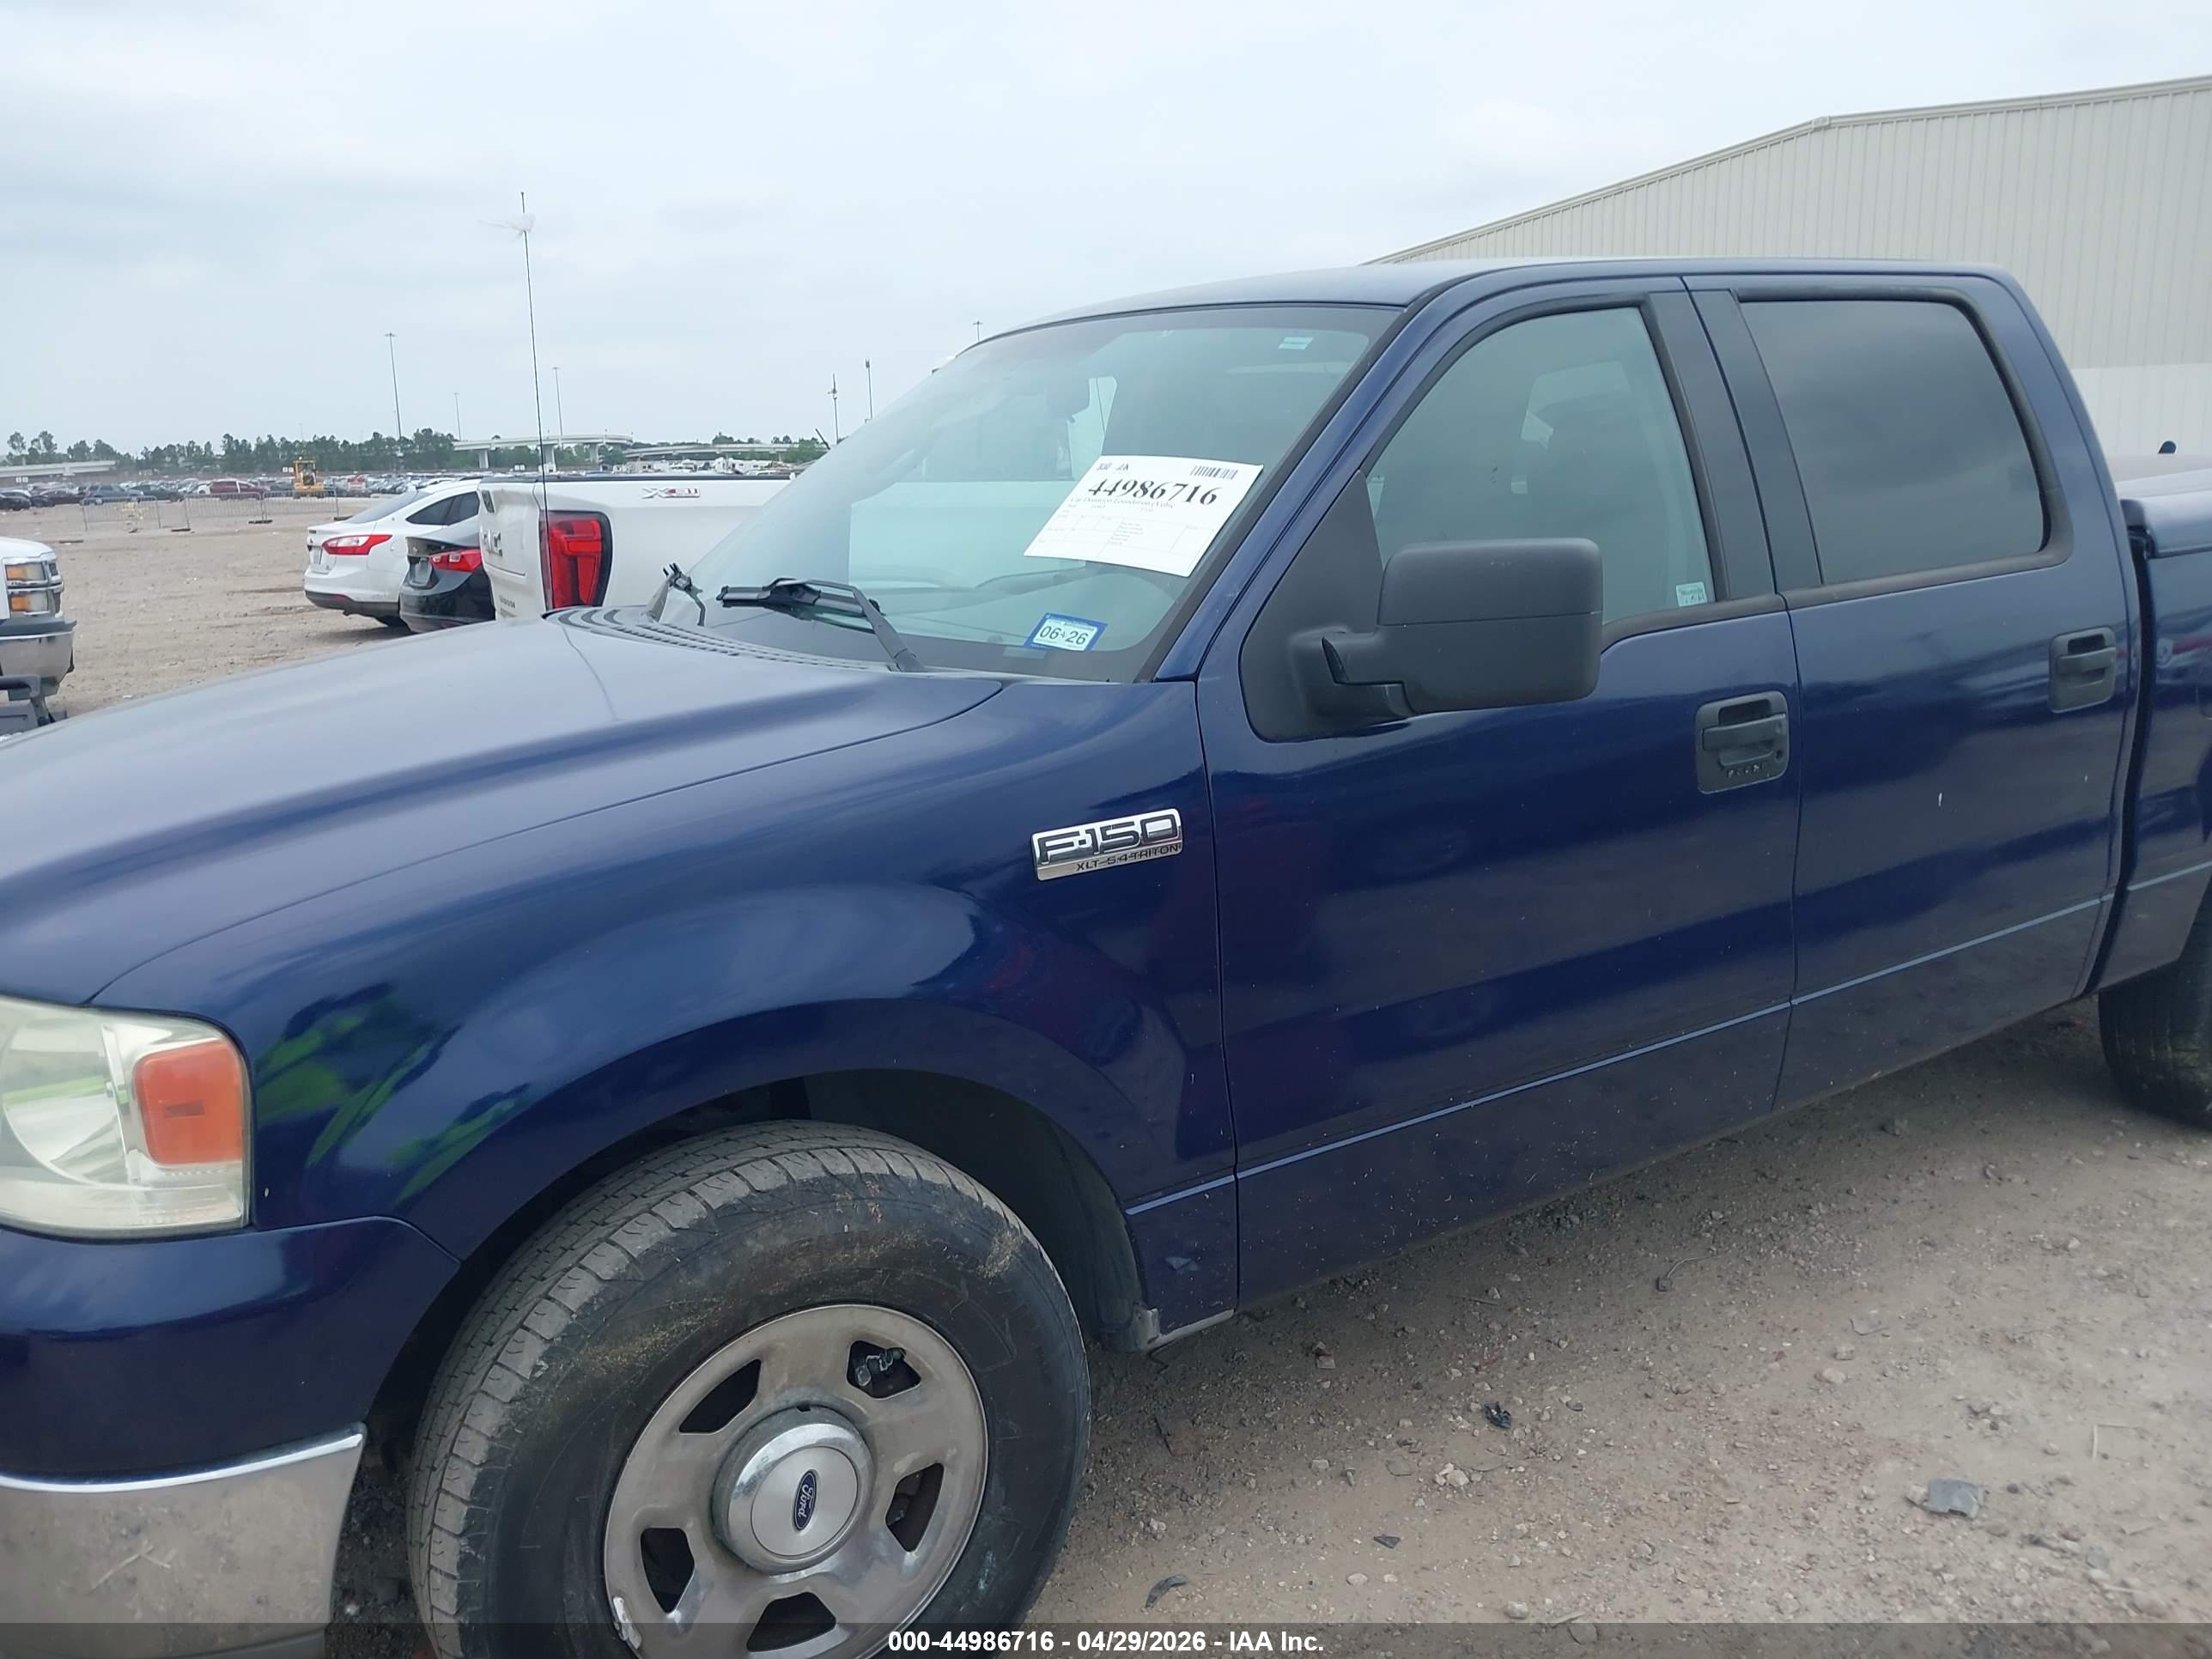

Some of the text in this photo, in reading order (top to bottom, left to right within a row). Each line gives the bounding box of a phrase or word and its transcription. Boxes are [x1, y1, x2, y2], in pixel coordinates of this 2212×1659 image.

[1088, 477, 1224, 506] 44986716
[1039, 626, 1089, 645] 06 26
[1036, 812, 1181, 866] F-150
[797, 1484, 814, 1518] Ford
